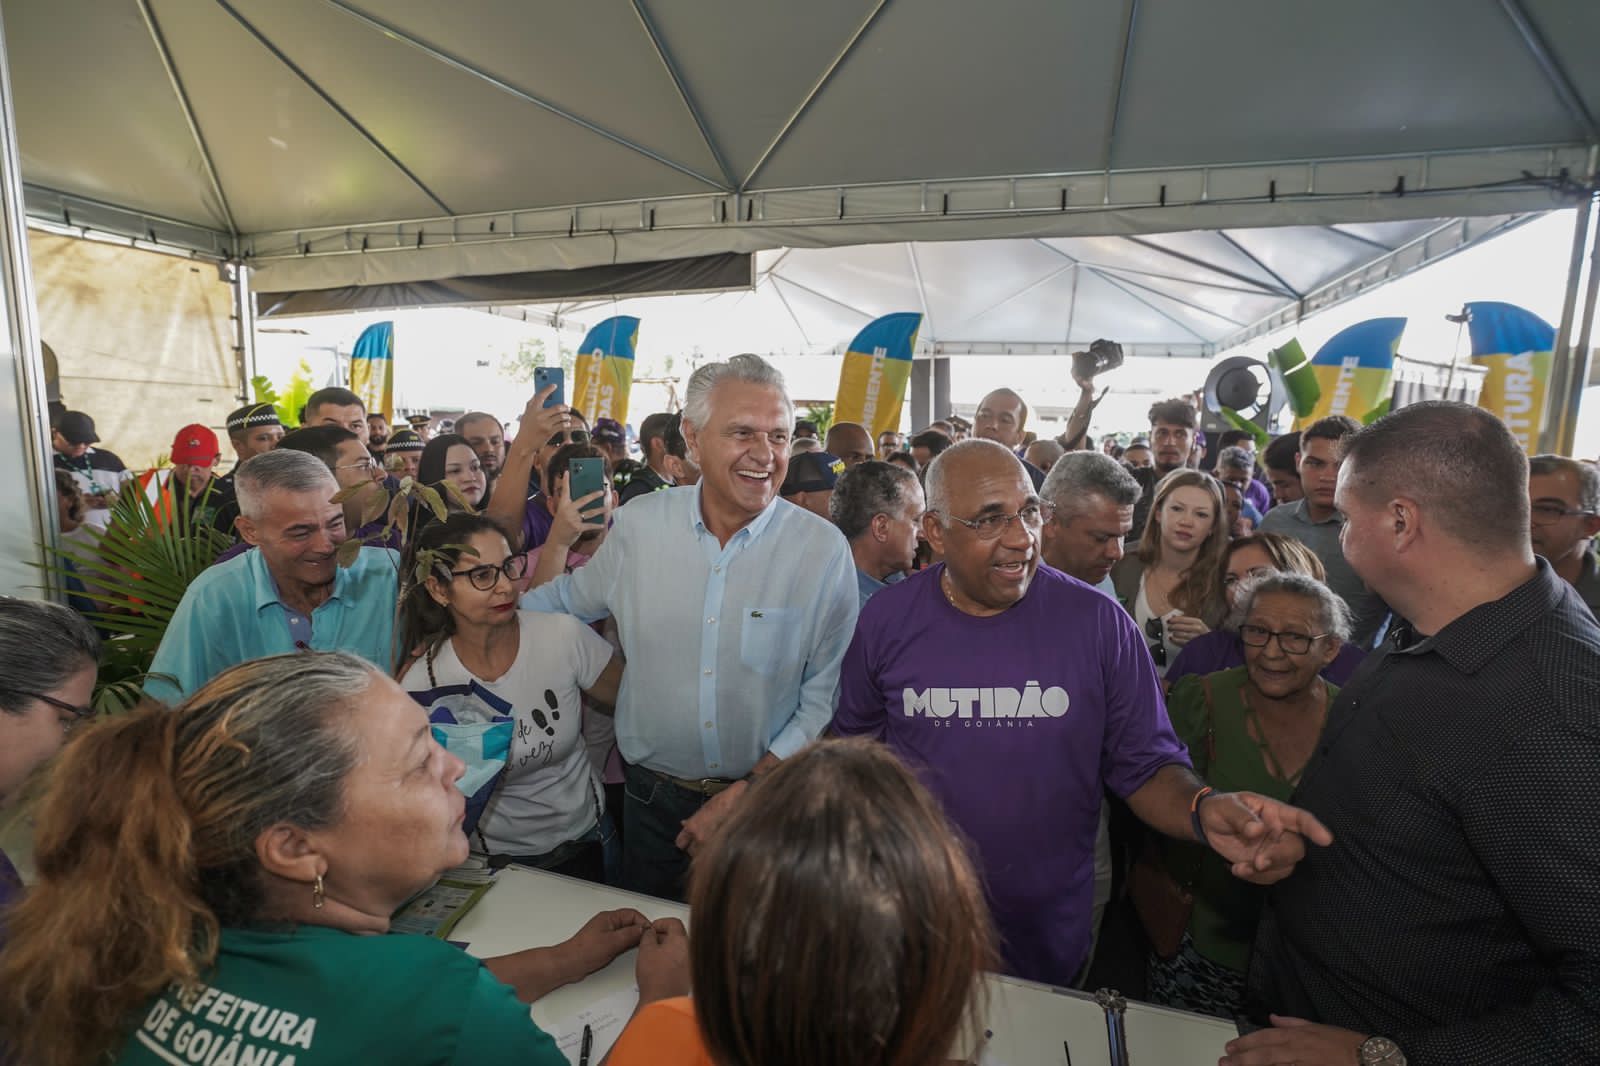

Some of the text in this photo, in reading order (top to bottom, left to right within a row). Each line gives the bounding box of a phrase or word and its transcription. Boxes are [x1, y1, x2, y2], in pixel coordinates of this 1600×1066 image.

[902, 680, 1070, 718] MUTIRÃO
[934, 718, 1034, 728] DE GOIÂNIA
[144, 998, 181, 1043] DE
[168, 980, 317, 1050] EFEITURA
